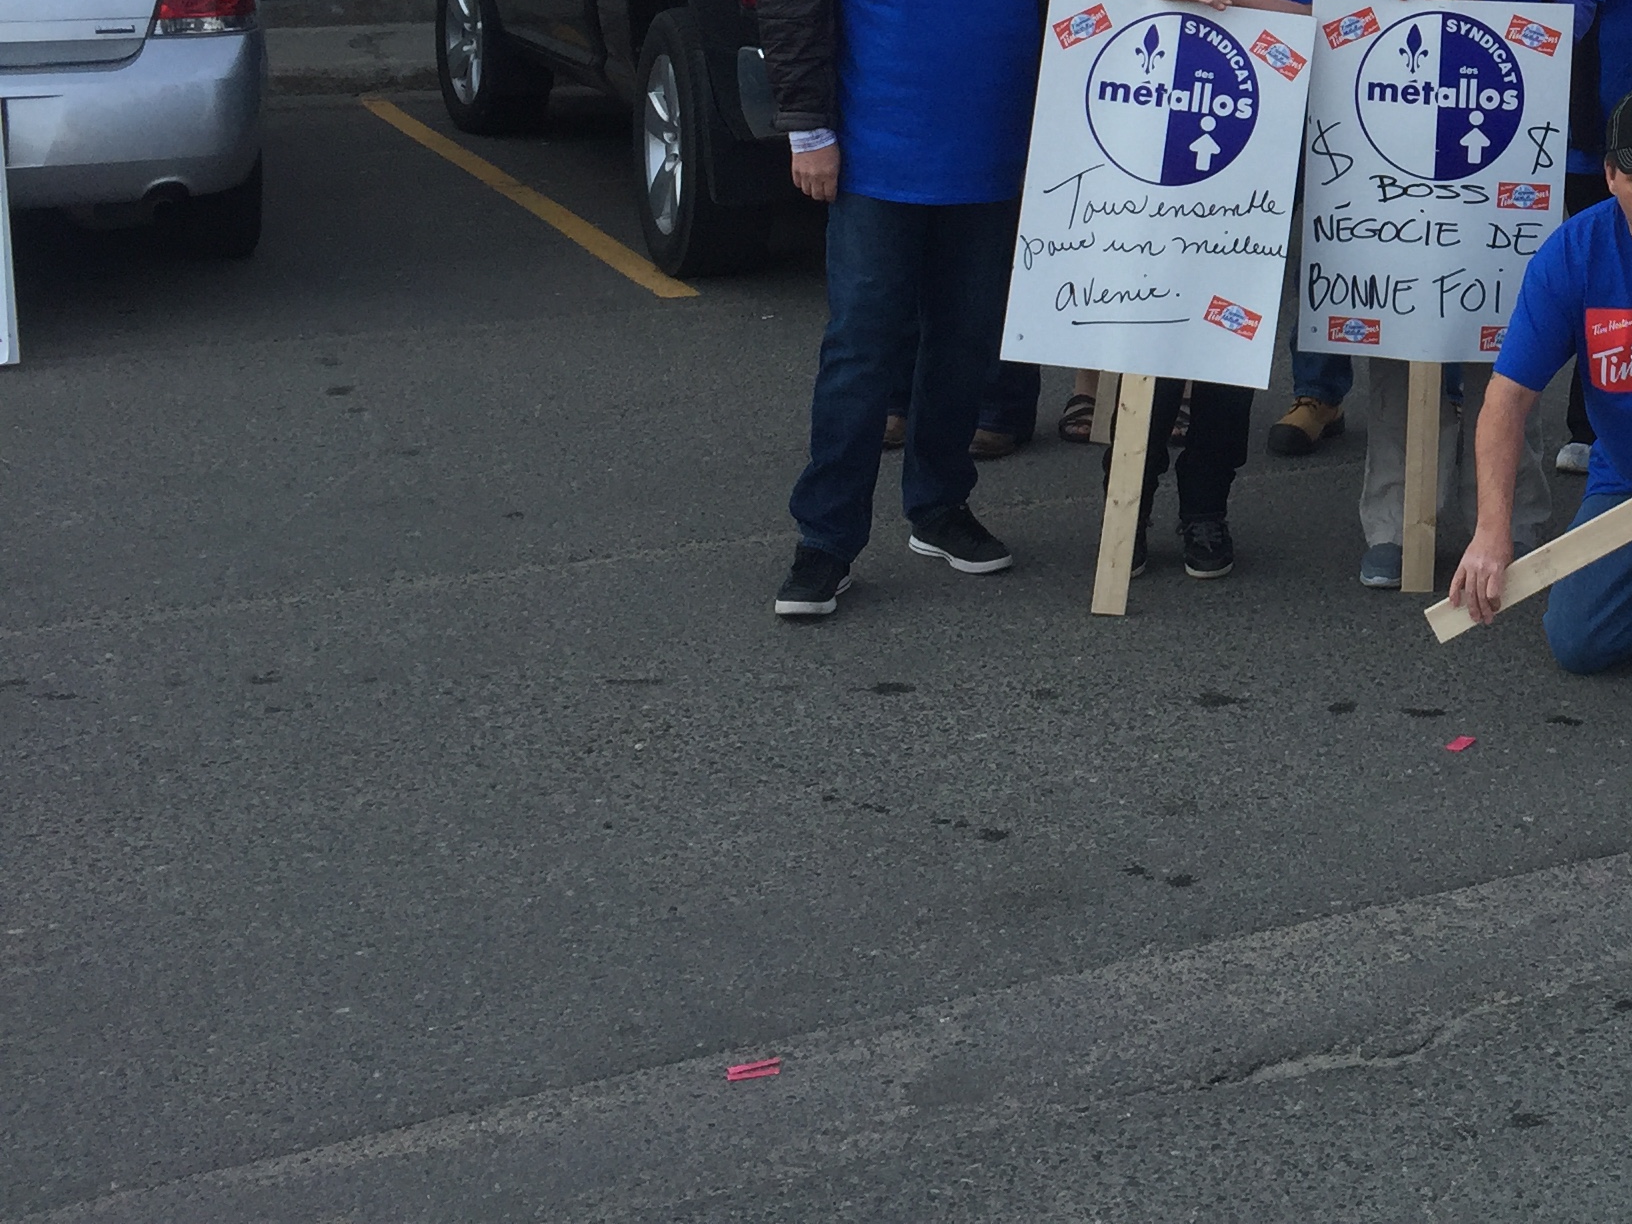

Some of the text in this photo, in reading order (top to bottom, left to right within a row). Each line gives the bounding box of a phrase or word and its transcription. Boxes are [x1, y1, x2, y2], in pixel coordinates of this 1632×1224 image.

[1184, 20, 1254, 94] SYNDICAT
[1446, 18, 1518, 85] SYNDICAT
[1459, 65, 1479, 76] des
[1194, 69, 1215, 80] des
[1367, 78, 1520, 112] métallos
[1098, 79, 1254, 121] métallos
[1369, 174, 1490, 205] BOSS
[1313, 201, 1544, 256] NÉGOCIE DE
[1308, 262, 1419, 316] BONNE
